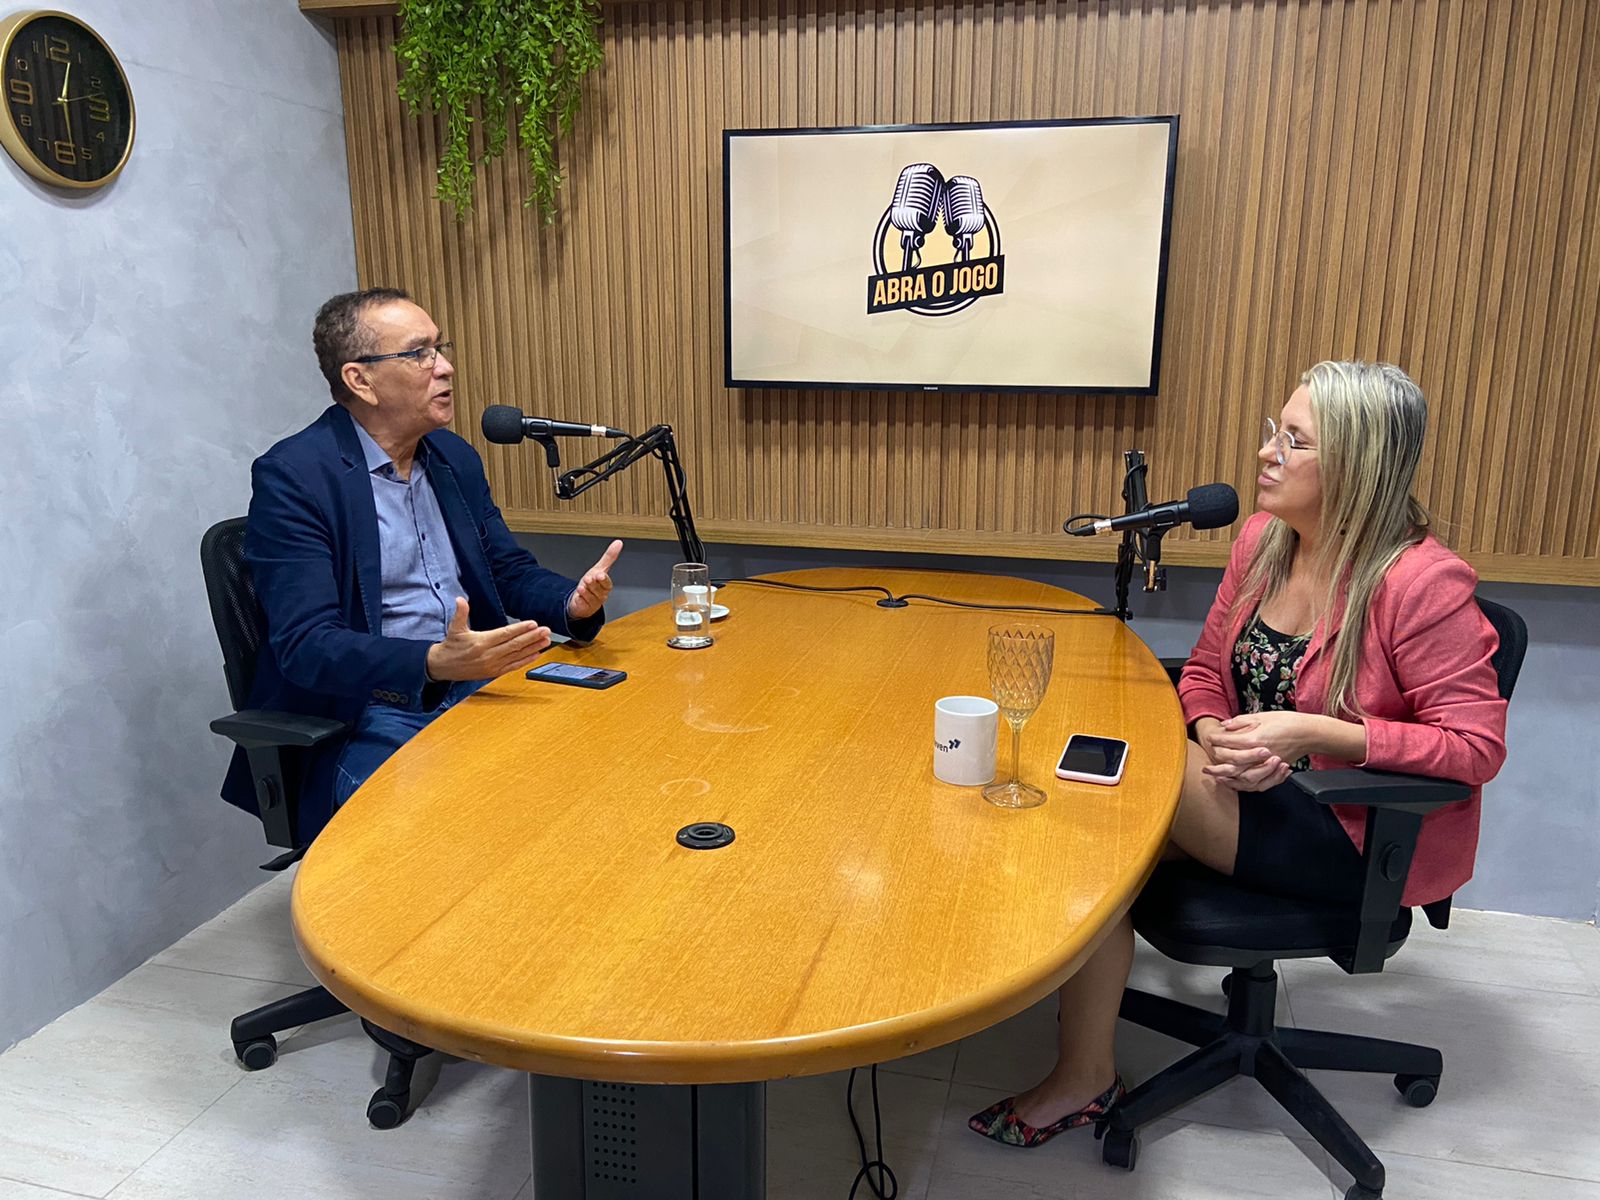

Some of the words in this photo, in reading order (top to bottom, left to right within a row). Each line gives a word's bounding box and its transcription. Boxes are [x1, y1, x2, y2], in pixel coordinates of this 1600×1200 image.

[44, 34, 71, 63] 12
[10, 78, 33, 105] 9
[91, 75, 103, 88] 2
[88, 92, 111, 122] 3
[20, 114, 32, 127] 8
[95, 131, 105, 143] 4
[54, 140, 77, 166] 6
[81, 147, 93, 160] 5
[873, 273, 927, 307] ABRA
[932, 270, 945, 297] O
[949, 262, 998, 296] JOGO
